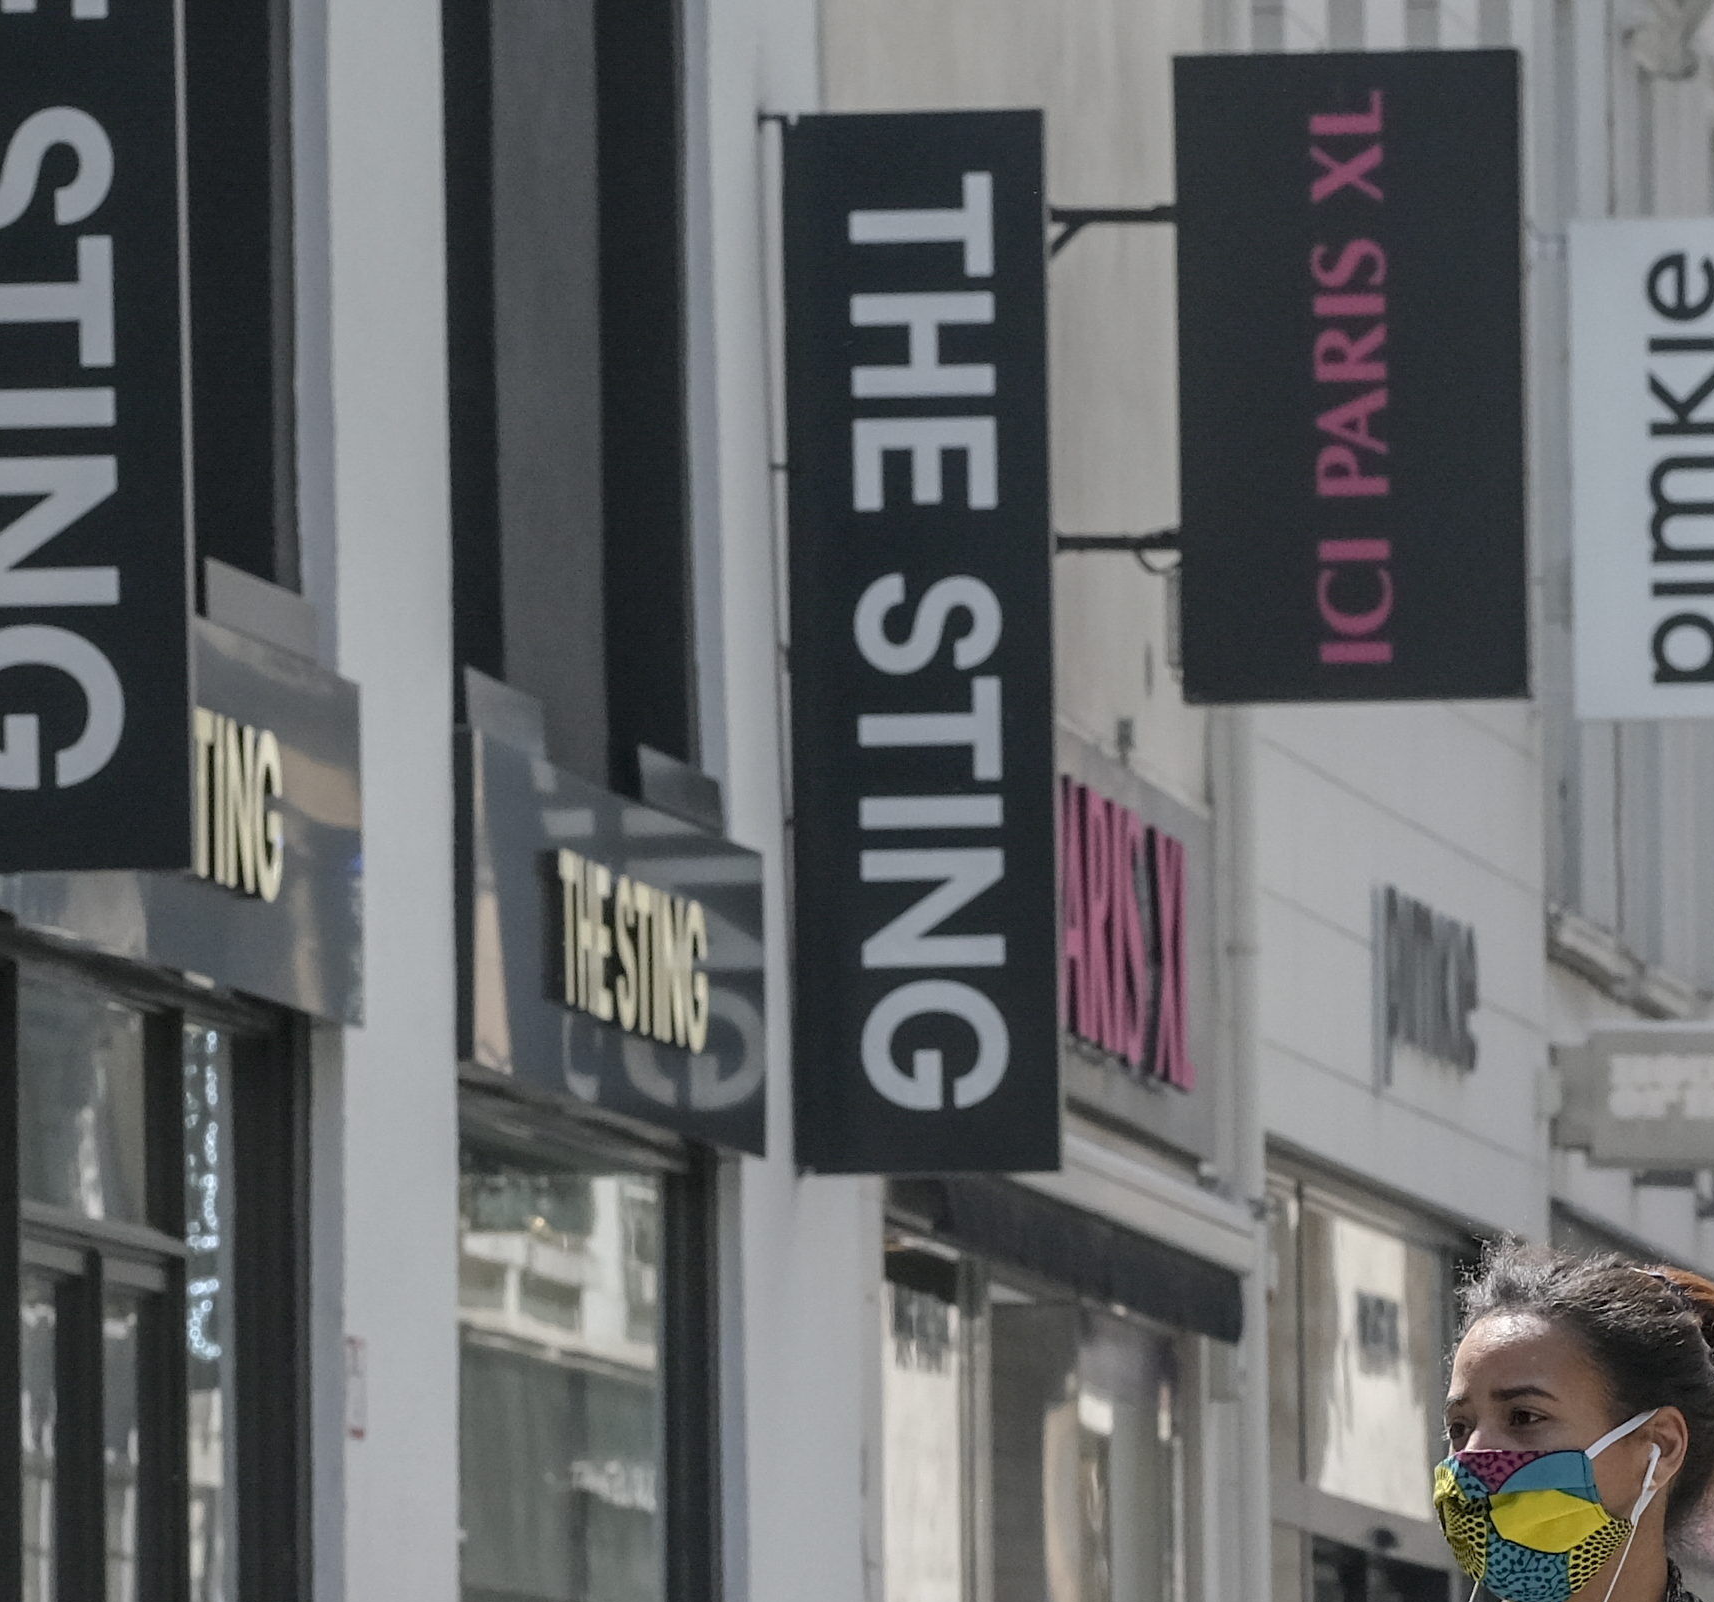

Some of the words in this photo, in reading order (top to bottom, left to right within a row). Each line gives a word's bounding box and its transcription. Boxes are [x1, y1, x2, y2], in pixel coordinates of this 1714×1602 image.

[1308, 88, 1385, 203] XL
[847, 170, 998, 513] THE
[1309, 236, 1390, 498] PARIS
[1316, 538, 1395, 664] ICI
[558, 847, 614, 1021] THE
[615, 874, 709, 1055] STING
[852, 571, 1011, 1111] STING
